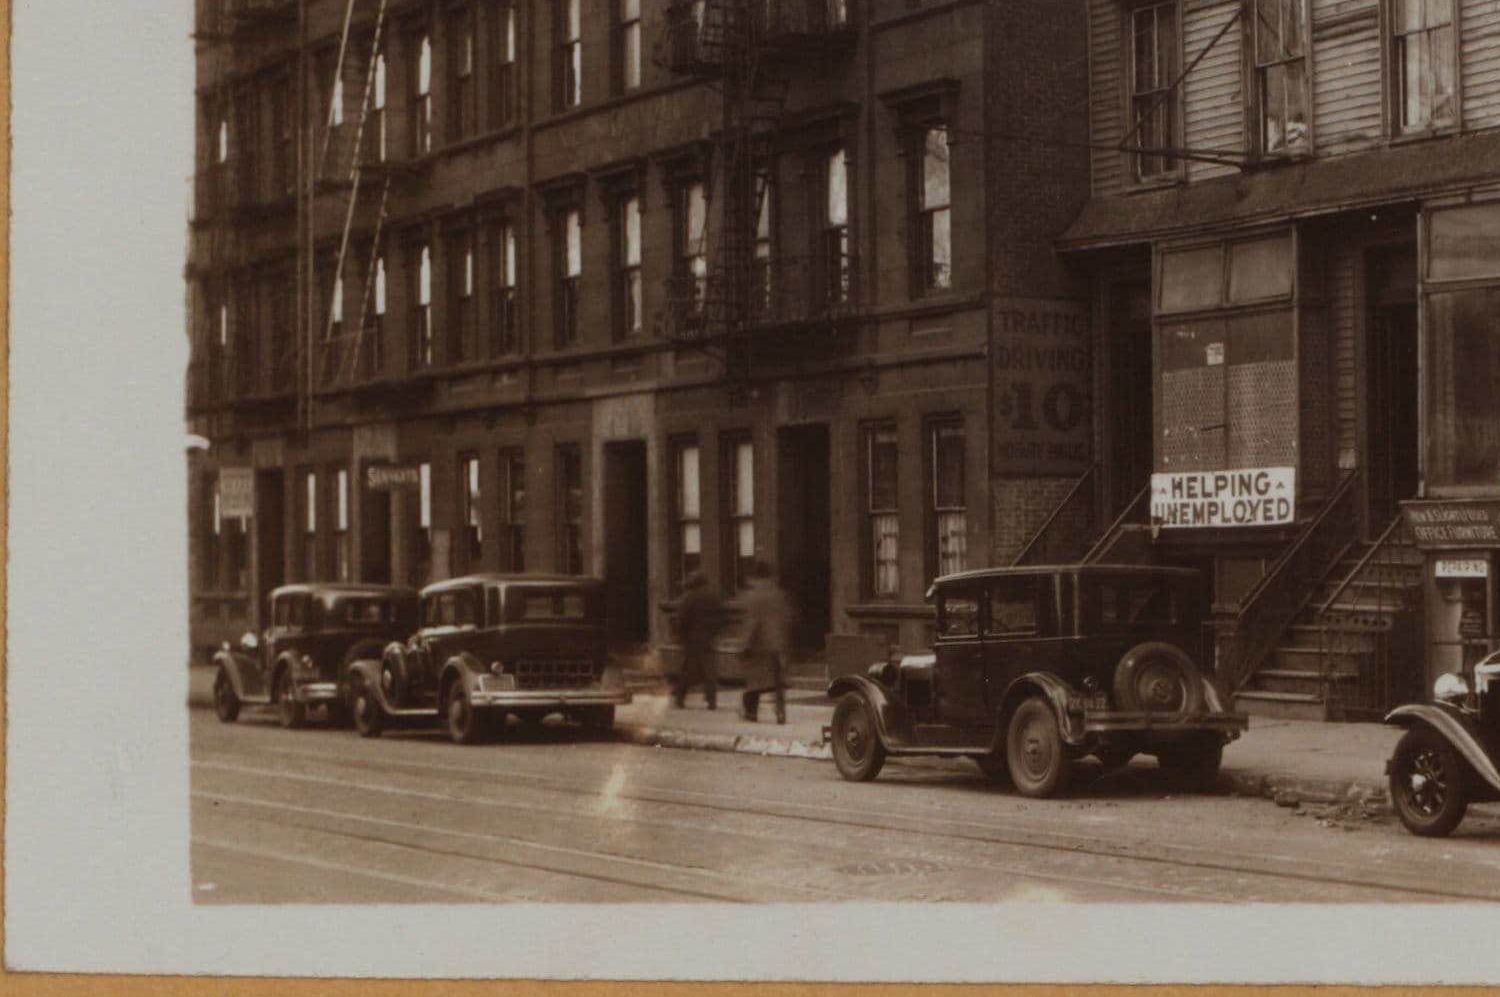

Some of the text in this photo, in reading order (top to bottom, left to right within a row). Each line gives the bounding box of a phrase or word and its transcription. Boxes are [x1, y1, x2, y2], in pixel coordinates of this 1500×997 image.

[999, 310, 1088, 335] TRAFFIC
[998, 346, 1086, 372] DRIVING
[1172, 472, 1270, 499] HELPING
[1154, 498, 1290, 524] UNEMPLOYED
